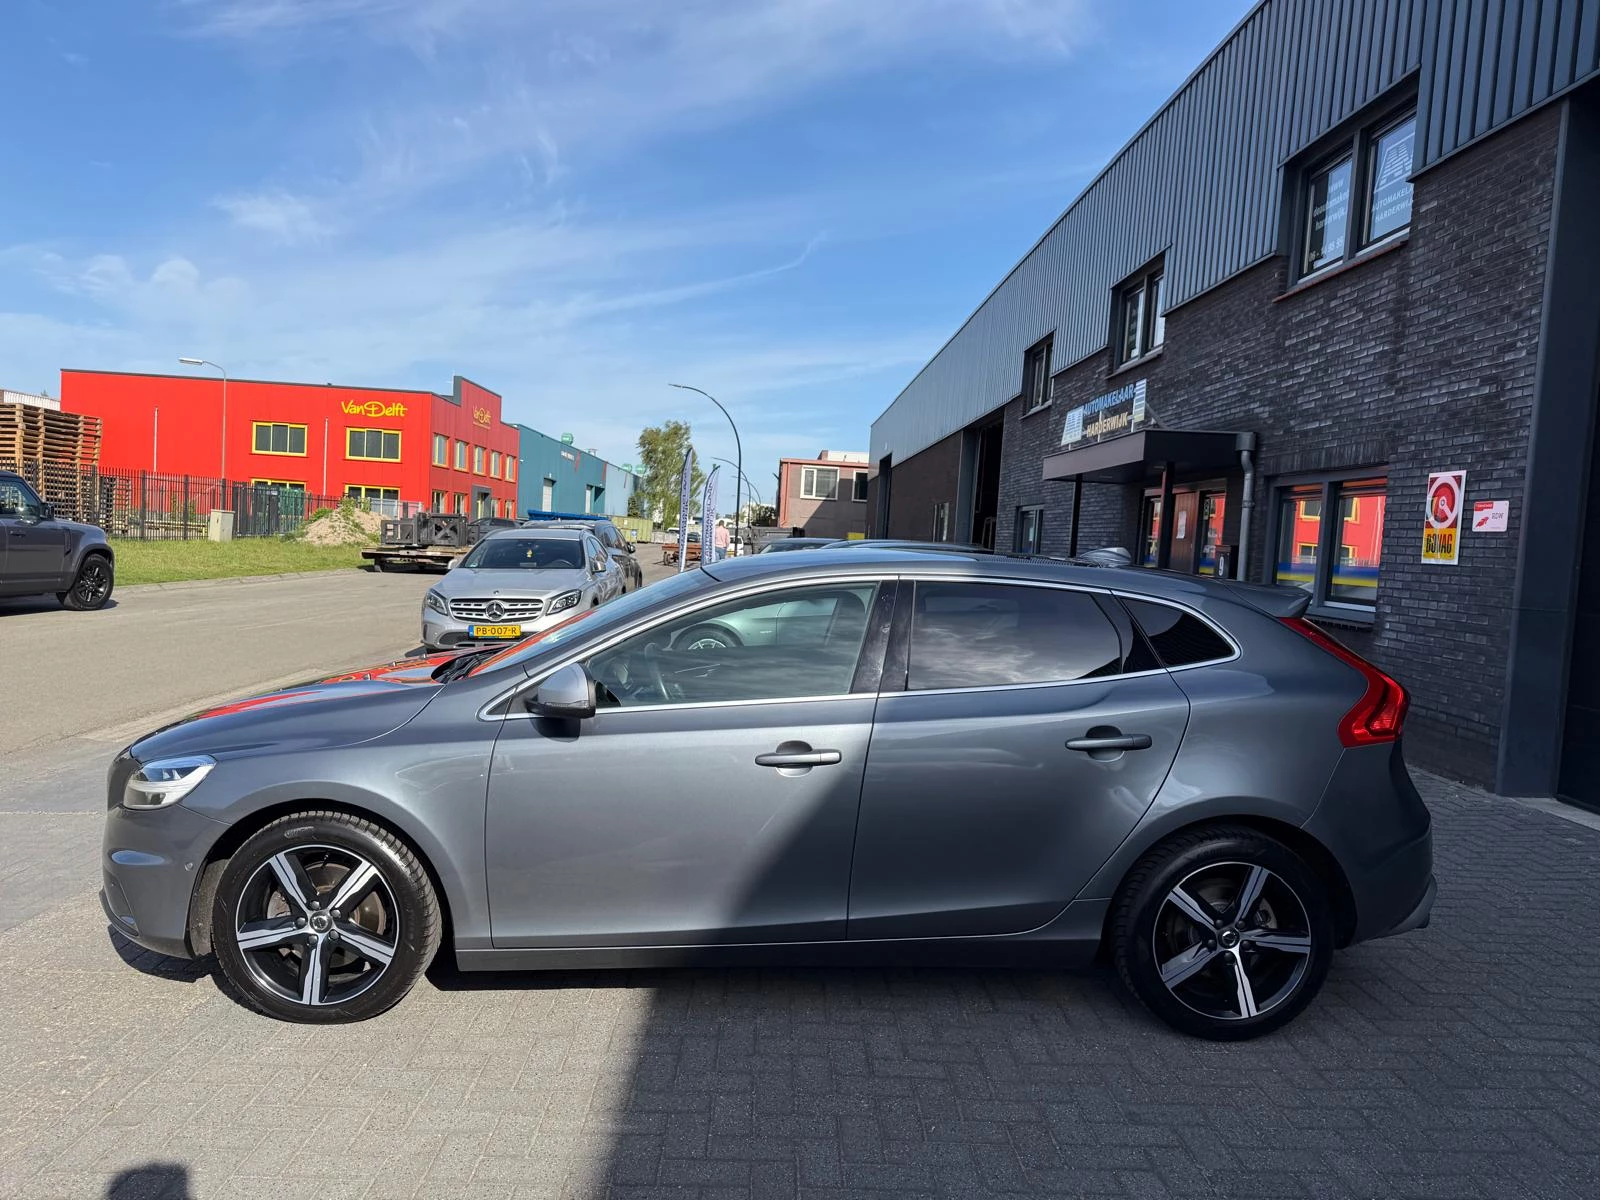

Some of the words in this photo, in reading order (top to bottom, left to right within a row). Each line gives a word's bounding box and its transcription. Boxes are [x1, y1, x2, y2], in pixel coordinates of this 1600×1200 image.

[341, 399, 365, 415] Van
[364, 400, 408, 417] Delft
[1083, 384, 1135, 416] AUTOMAKELAAR
[1087, 411, 1128, 438] HARDERWIJK
[1425, 533, 1453, 553] BOVAG
[476, 627, 517, 635] PB-007-R
